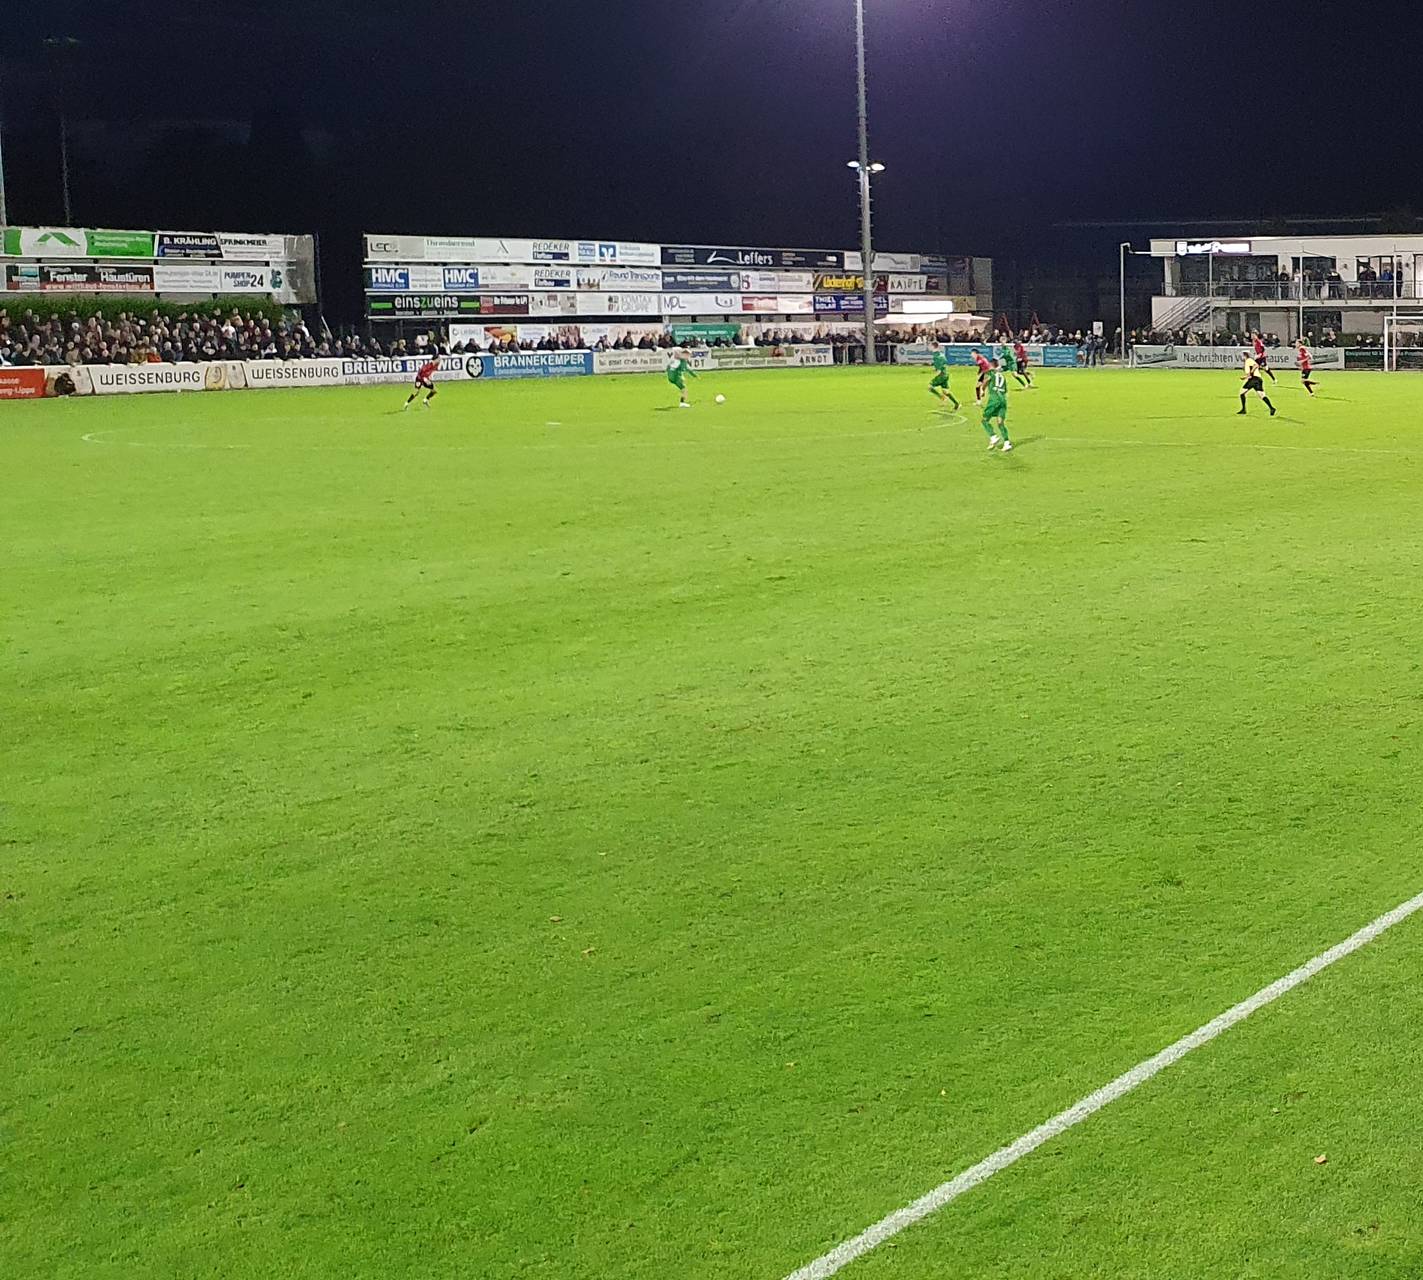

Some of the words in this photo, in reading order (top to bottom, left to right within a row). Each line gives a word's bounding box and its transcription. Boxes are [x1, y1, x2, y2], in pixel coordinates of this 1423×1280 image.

[174, 237, 217, 245] KRÄHLING
[532, 242, 570, 251] REDEKER
[738, 251, 774, 265] Leffers
[50, 271, 88, 282] Fenster
[101, 271, 151, 283] Haustüren
[371, 268, 405, 283] HMC
[444, 269, 475, 283] HMC
[534, 269, 571, 278] REDEKER
[250, 274, 264, 288] 24
[394, 295, 459, 309] einszueins
[494, 354, 585, 368] BRANNEKEMPER
[1183, 352, 1234, 364] Nachrichten
[251, 366, 339, 379] WEISSENBURG
[343, 359, 402, 375] BRIEWIG
[100, 370, 201, 386] WEISSENBURG
